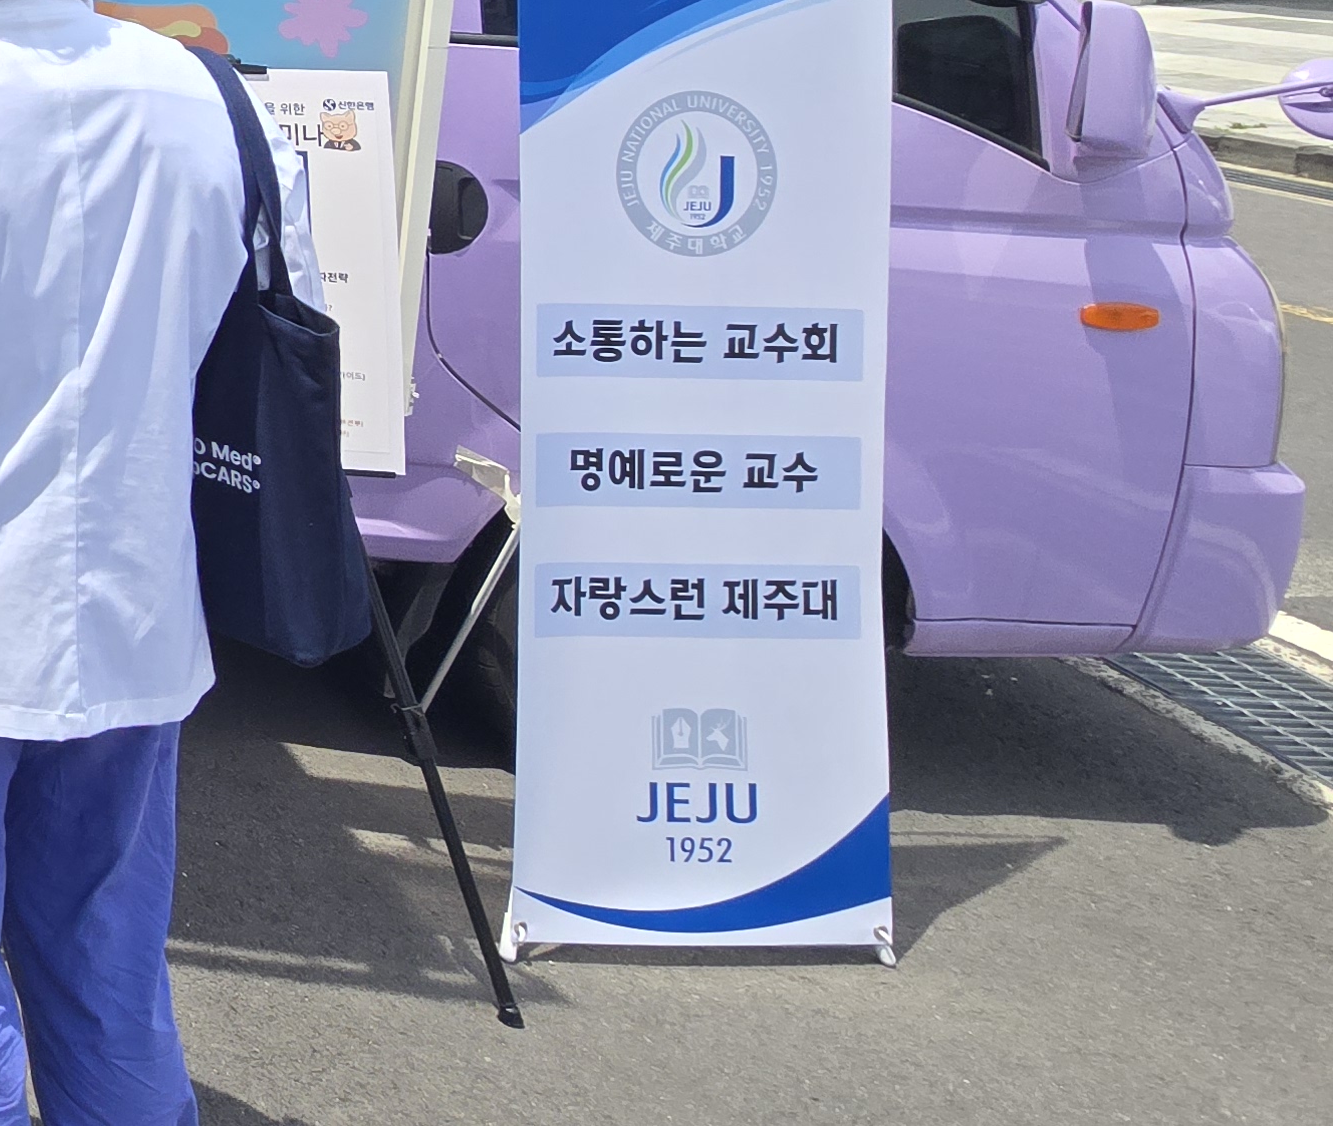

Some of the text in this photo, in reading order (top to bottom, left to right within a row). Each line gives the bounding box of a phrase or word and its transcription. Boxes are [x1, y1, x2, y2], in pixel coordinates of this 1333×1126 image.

[280, 103, 305, 116] 위한
[338, 101, 375, 111] 신한은행
[620, 95, 774, 211] JEJU NATIONAL UNIVERSITY 1952
[683, 201, 712, 212] JEJU
[646, 219, 747, 255] 제주대학교
[553, 320, 837, 363] 소통하는 교수회
[570, 448, 818, 492] 명예로운 교수
[551, 577, 837, 620] 자랑스런 제주대
[637, 782, 757, 823] JEJU
[666, 837, 732, 862] 1952
